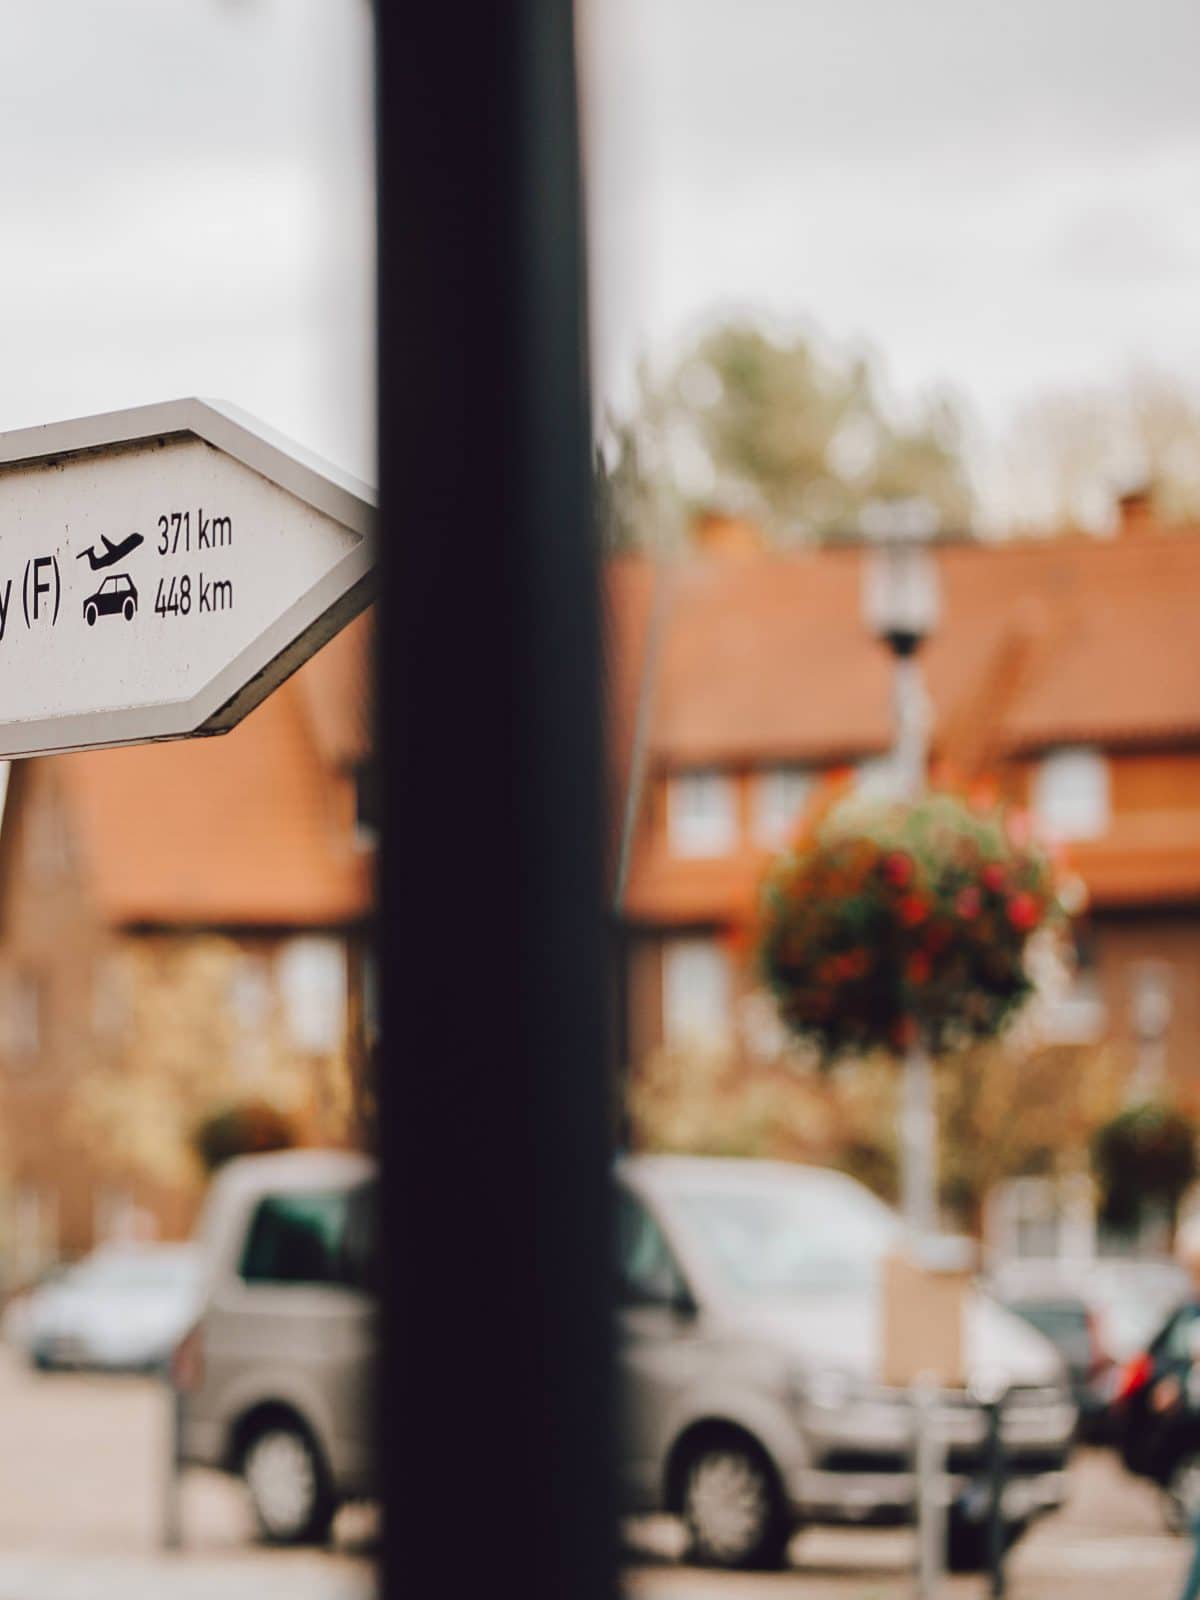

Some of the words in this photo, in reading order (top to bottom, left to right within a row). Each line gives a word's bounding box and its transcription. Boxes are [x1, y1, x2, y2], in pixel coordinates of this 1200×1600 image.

[157, 511, 190, 556] 371
[198, 508, 233, 550] km
[23, 556, 61, 630] (F)
[154, 574, 192, 619] 448
[199, 572, 233, 613] km
